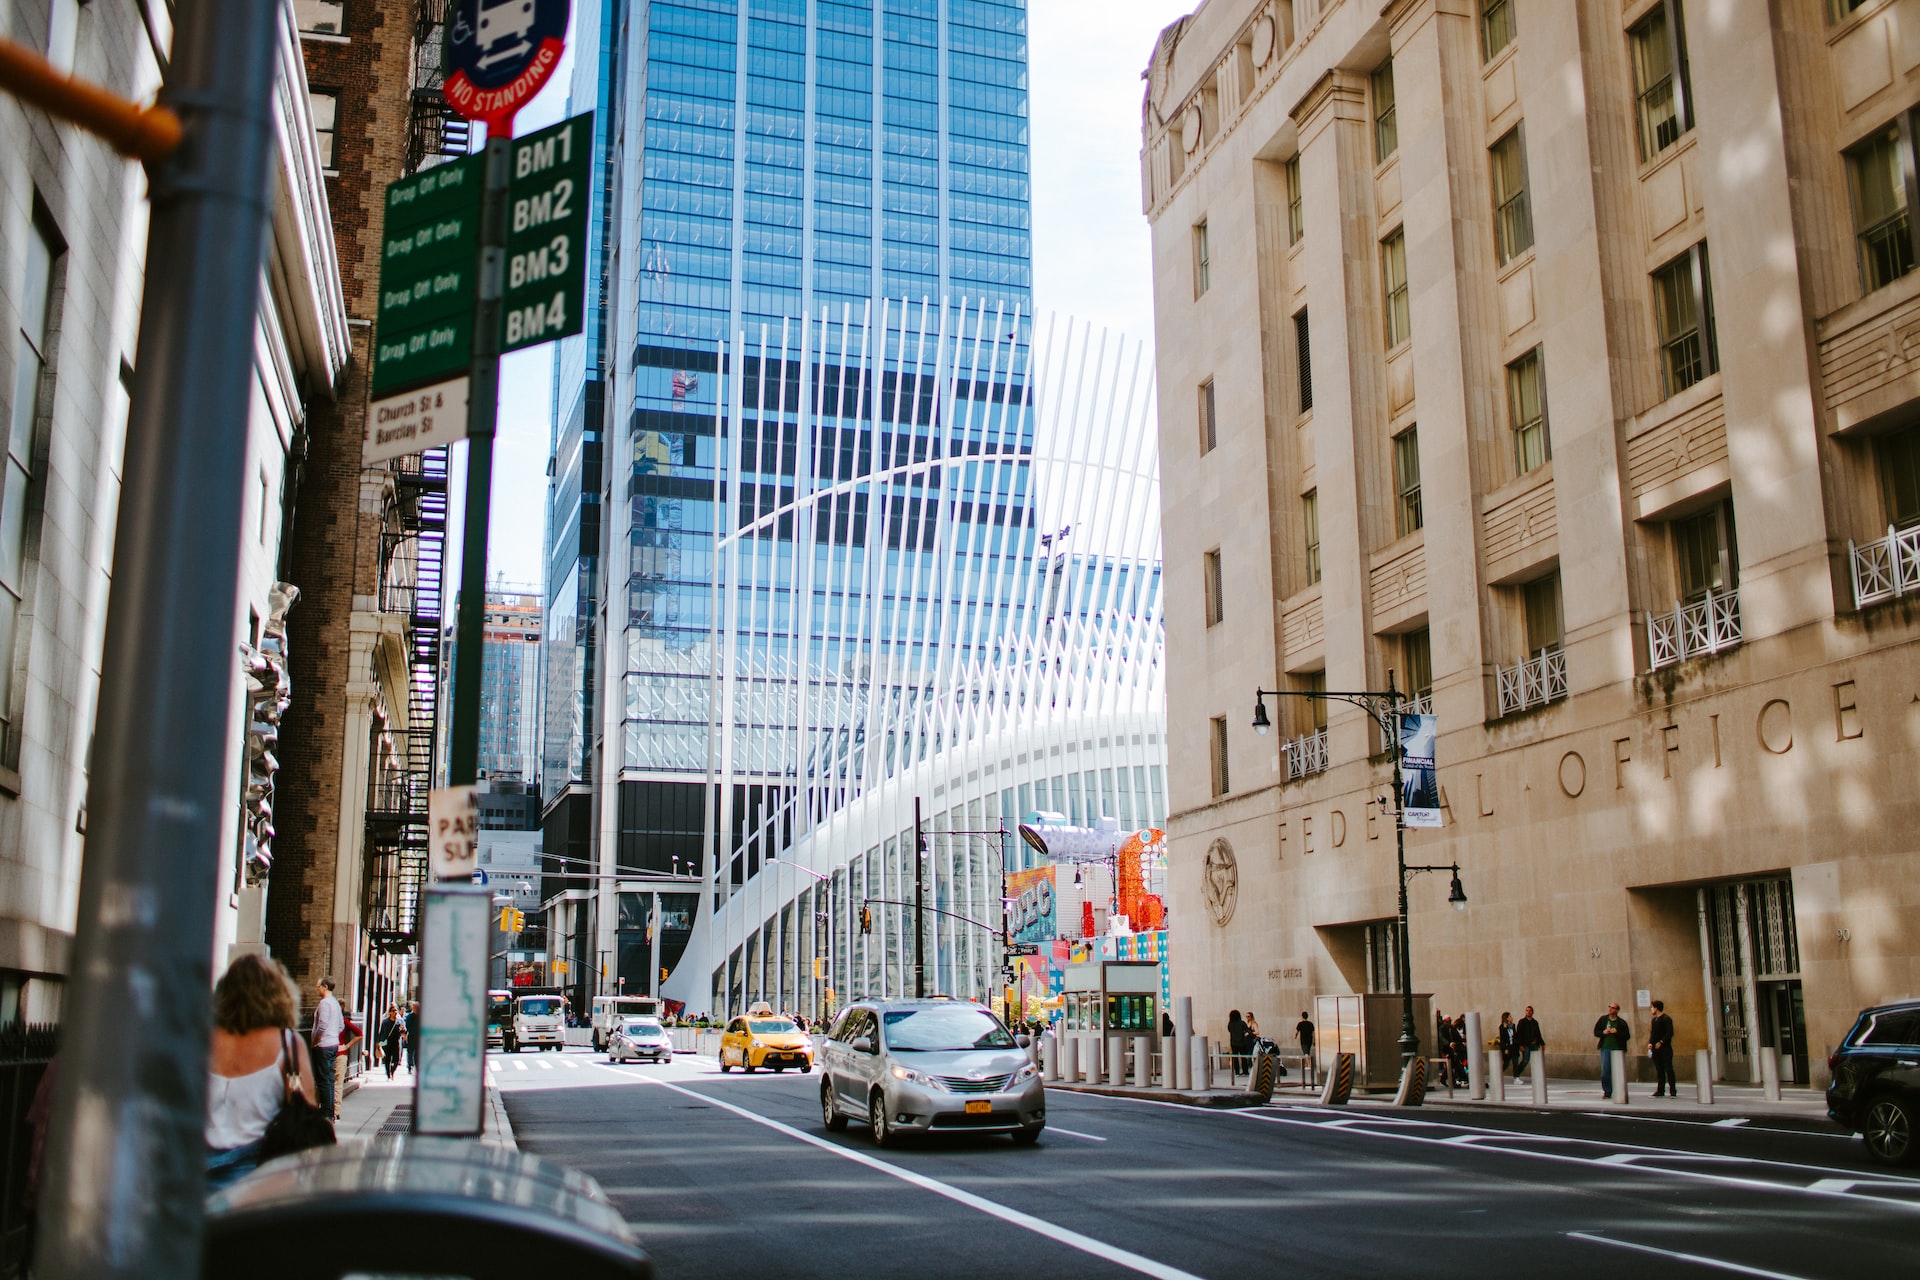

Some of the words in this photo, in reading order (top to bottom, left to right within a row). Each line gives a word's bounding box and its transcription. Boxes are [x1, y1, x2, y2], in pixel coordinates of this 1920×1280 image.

[452, 78, 473, 105] NO
[473, 48, 554, 111] STANDING
[516, 124, 572, 178] BM1
[391, 186, 416, 206] Drop
[439, 167, 465, 187] Only
[513, 178, 573, 233] BM2
[387, 237, 413, 257] Drop
[435, 219, 461, 240] Only
[510, 234, 569, 288] BM3
[384, 289, 411, 309] Drop
[433, 272, 460, 293] Only
[506, 291, 567, 344] BM4
[380, 343, 406, 362] Drop
[429, 326, 456, 348] Only
[377, 400, 415, 424] Church
[420, 396, 432, 412] St
[376, 424, 418, 445] Barclay
[421, 416, 433, 433] St
[1278, 773, 1494, 860] FEDEAL
[1558, 679, 1864, 798] OFFICE
[1402, 756, 1434, 765] FINANCIAL
[1007, 877, 1052, 938] WTC
[1835, 928, 1851, 943] 90
[1268, 969, 1281, 979] POST
[1283, 968, 1302, 979] OFFICE
